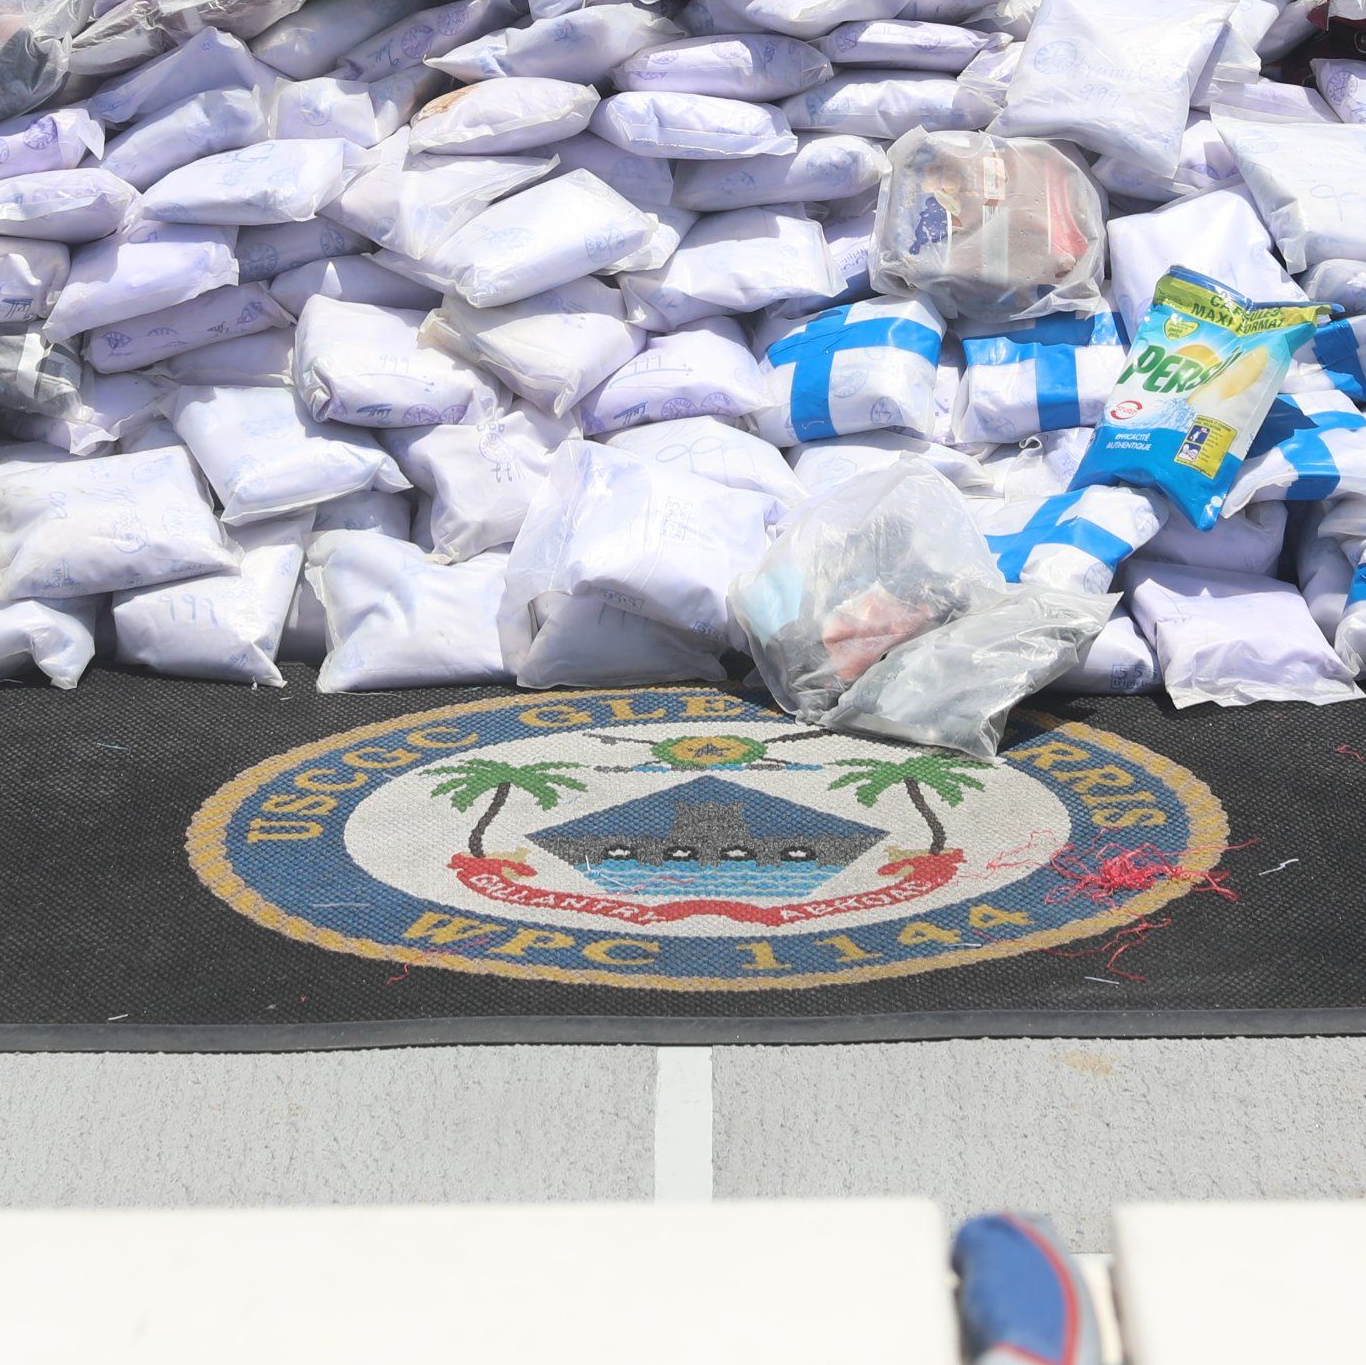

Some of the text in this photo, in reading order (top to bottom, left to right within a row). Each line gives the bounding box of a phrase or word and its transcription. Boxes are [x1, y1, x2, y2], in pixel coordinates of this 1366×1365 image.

[1191, 302, 1235, 328] MAXI
[160, 593, 219, 629] 999
[247, 726, 479, 844] USCGC
[520, 695, 785, 729] GLE
[402, 903, 1031, 970] WPC 1144
